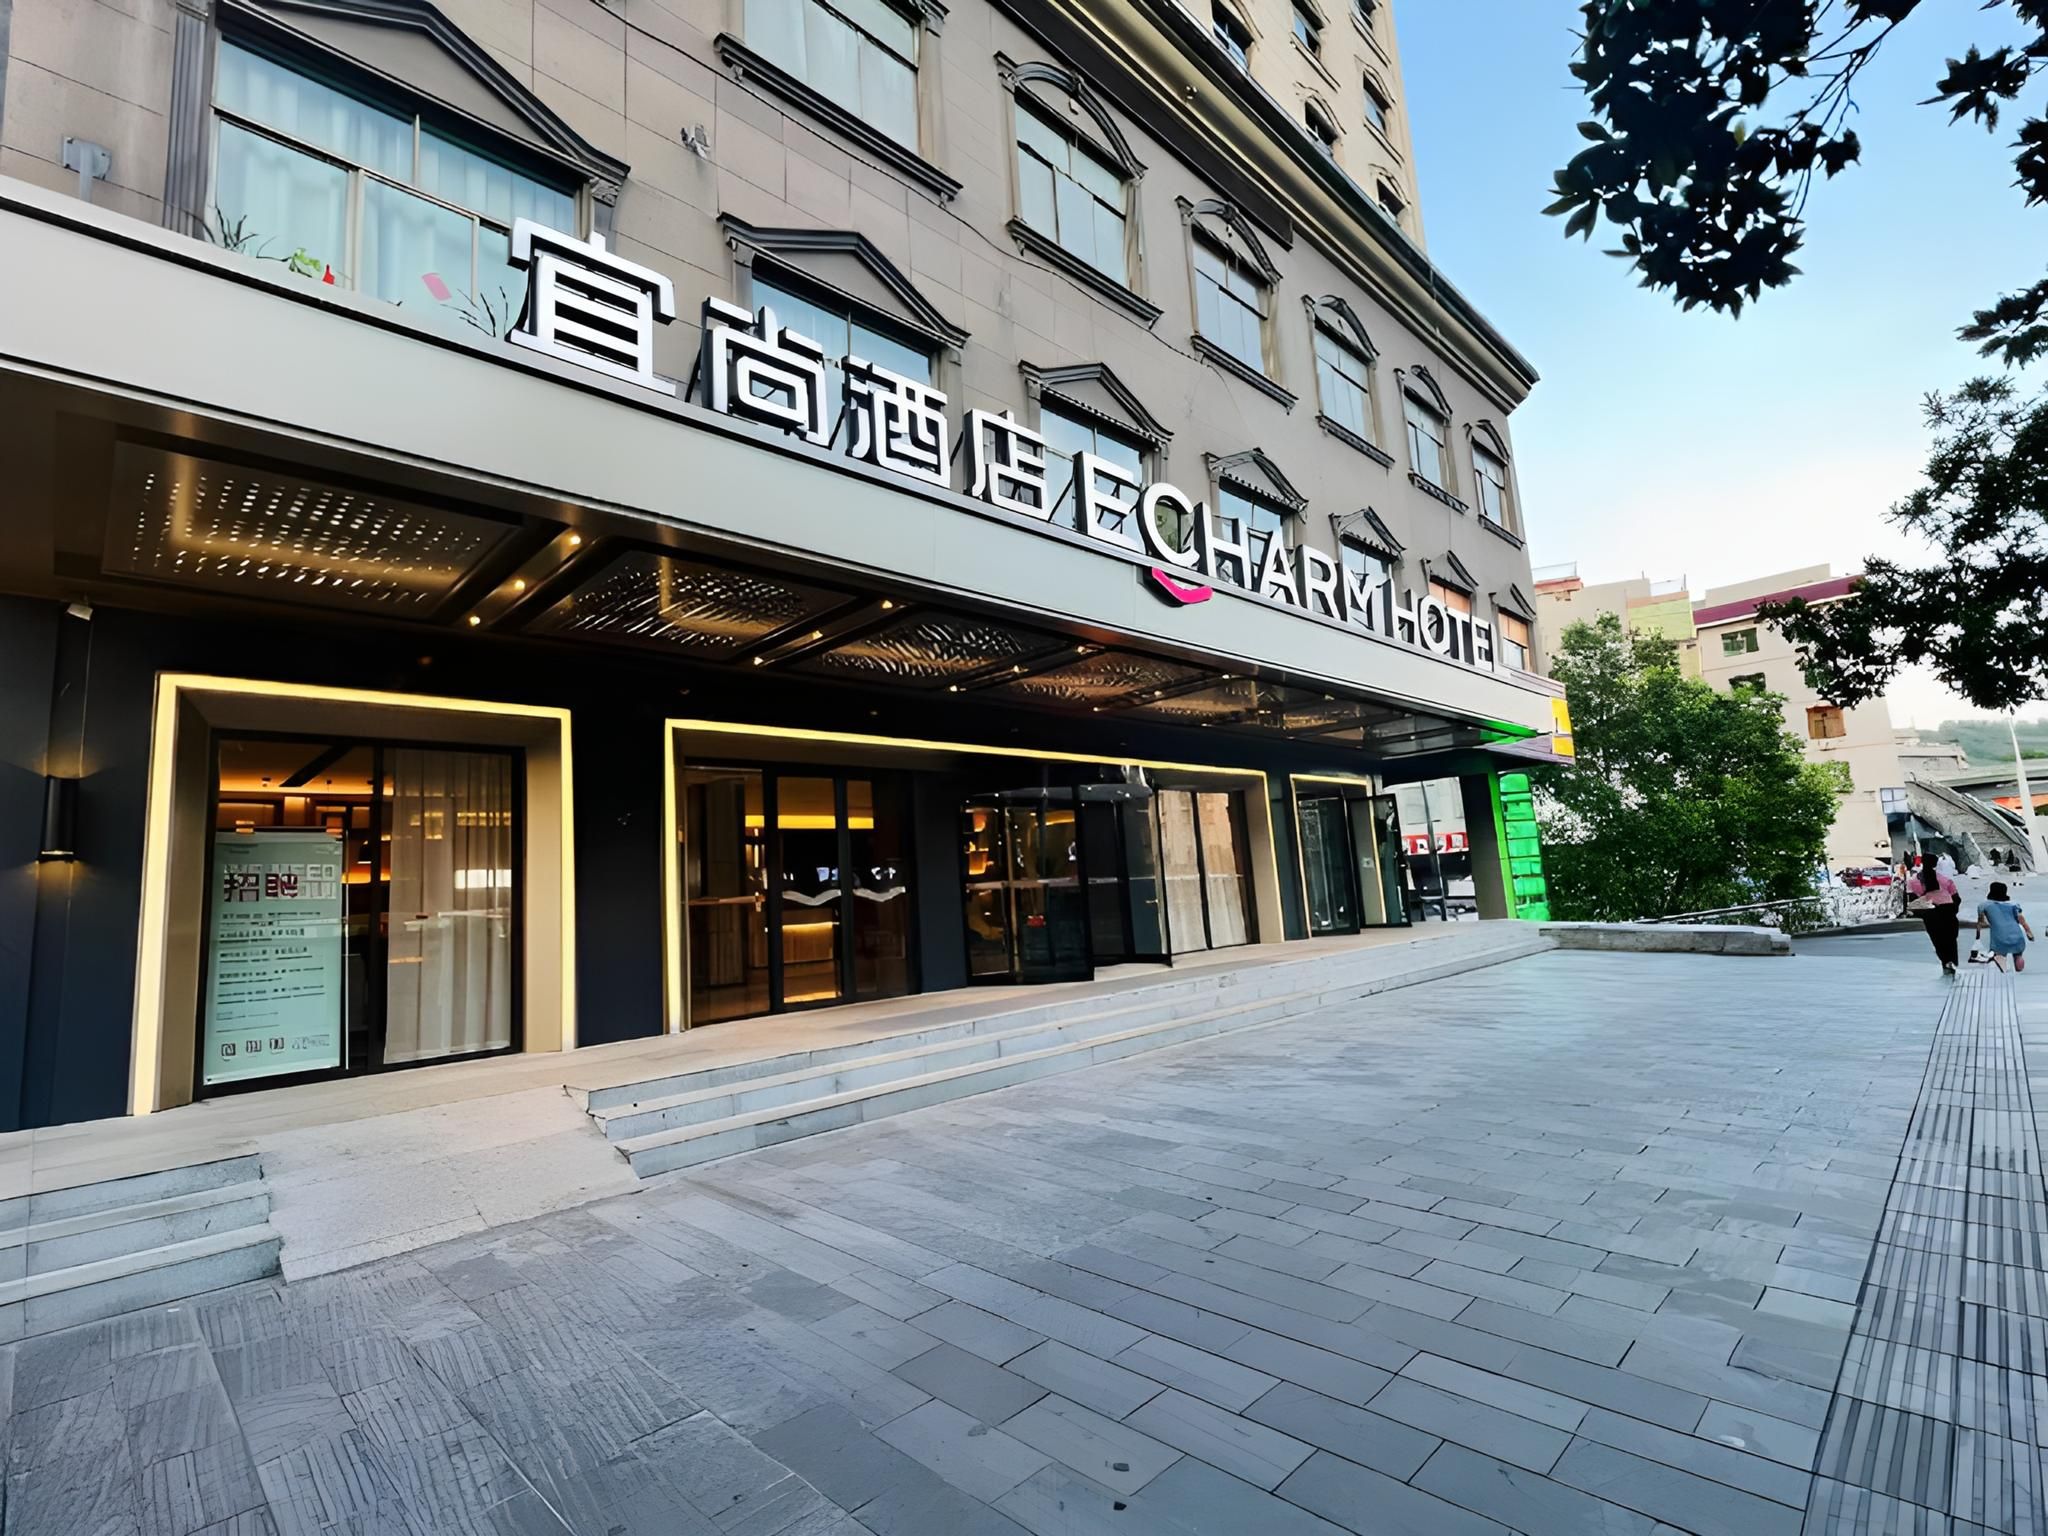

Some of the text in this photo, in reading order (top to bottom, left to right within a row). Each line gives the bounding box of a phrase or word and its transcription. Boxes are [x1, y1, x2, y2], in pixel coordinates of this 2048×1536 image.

[507, 217, 1050, 521] 宜尚酒店
[1074, 450, 1386, 633] ECHARM
